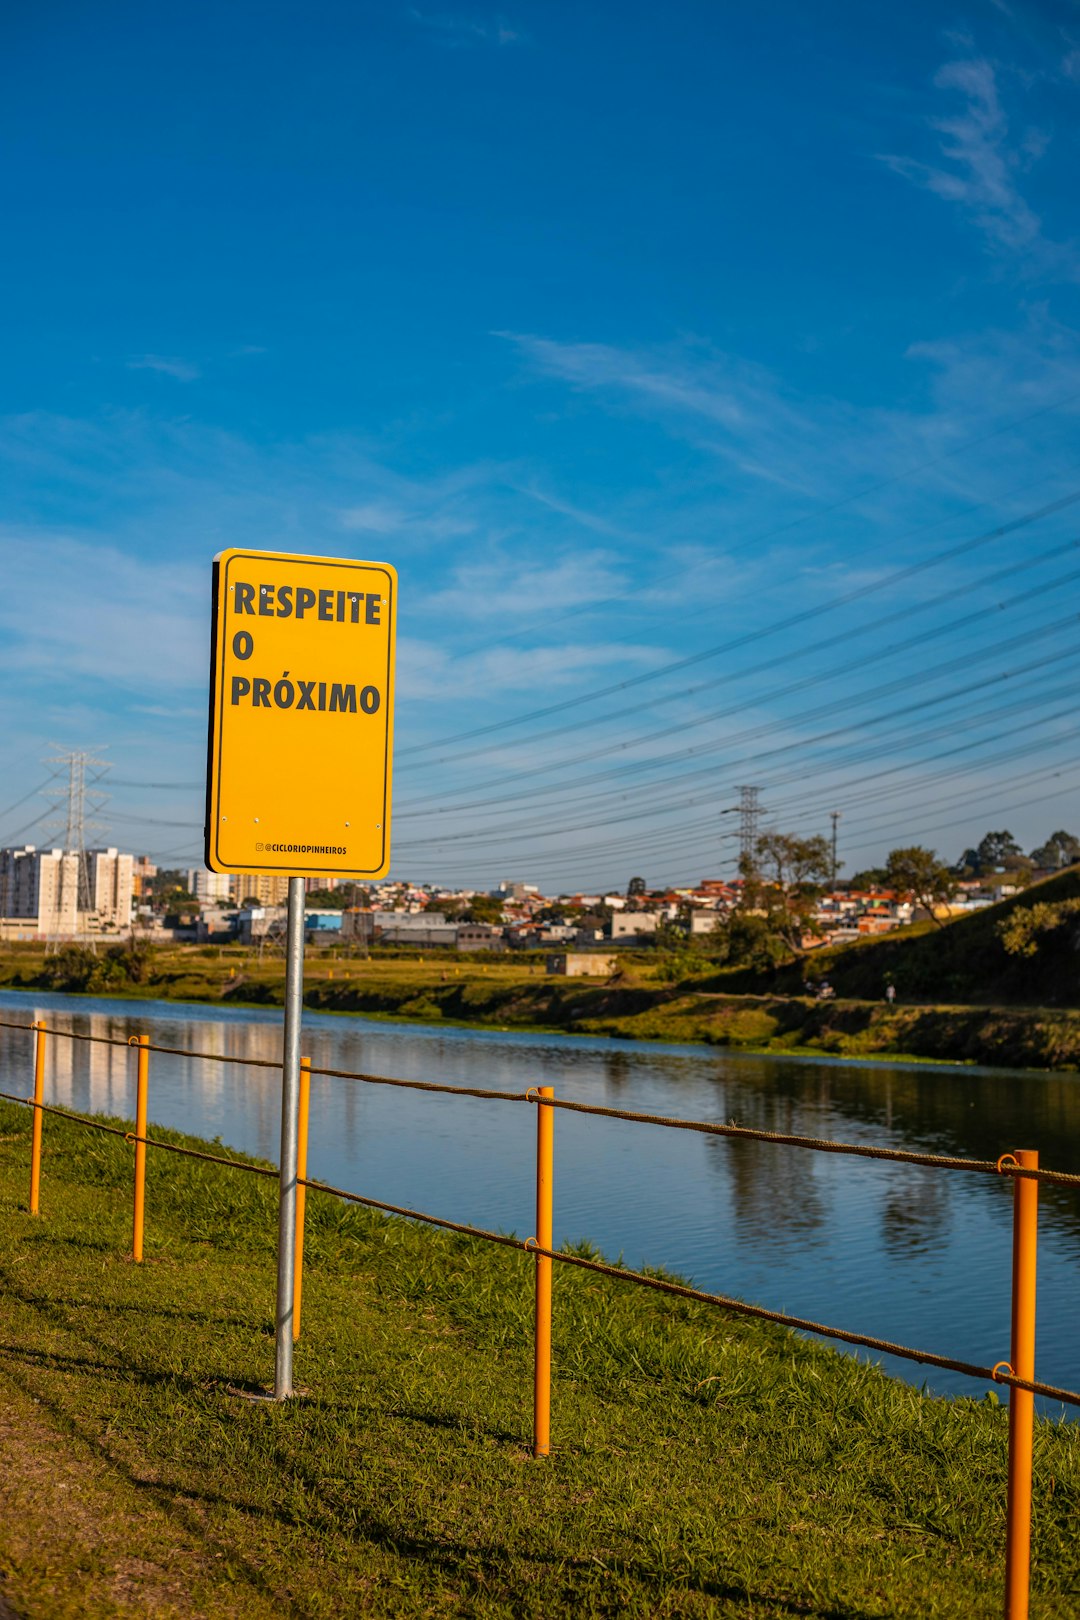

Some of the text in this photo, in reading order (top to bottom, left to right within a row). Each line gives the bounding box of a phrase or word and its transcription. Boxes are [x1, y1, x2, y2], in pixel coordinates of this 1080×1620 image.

[234, 582, 381, 625] RESPEITE
[233, 631, 254, 660] O
[231, 671, 381, 714] PRÓXIMO
[265, 844, 346, 854] @CICLORIOPINHEIROS
